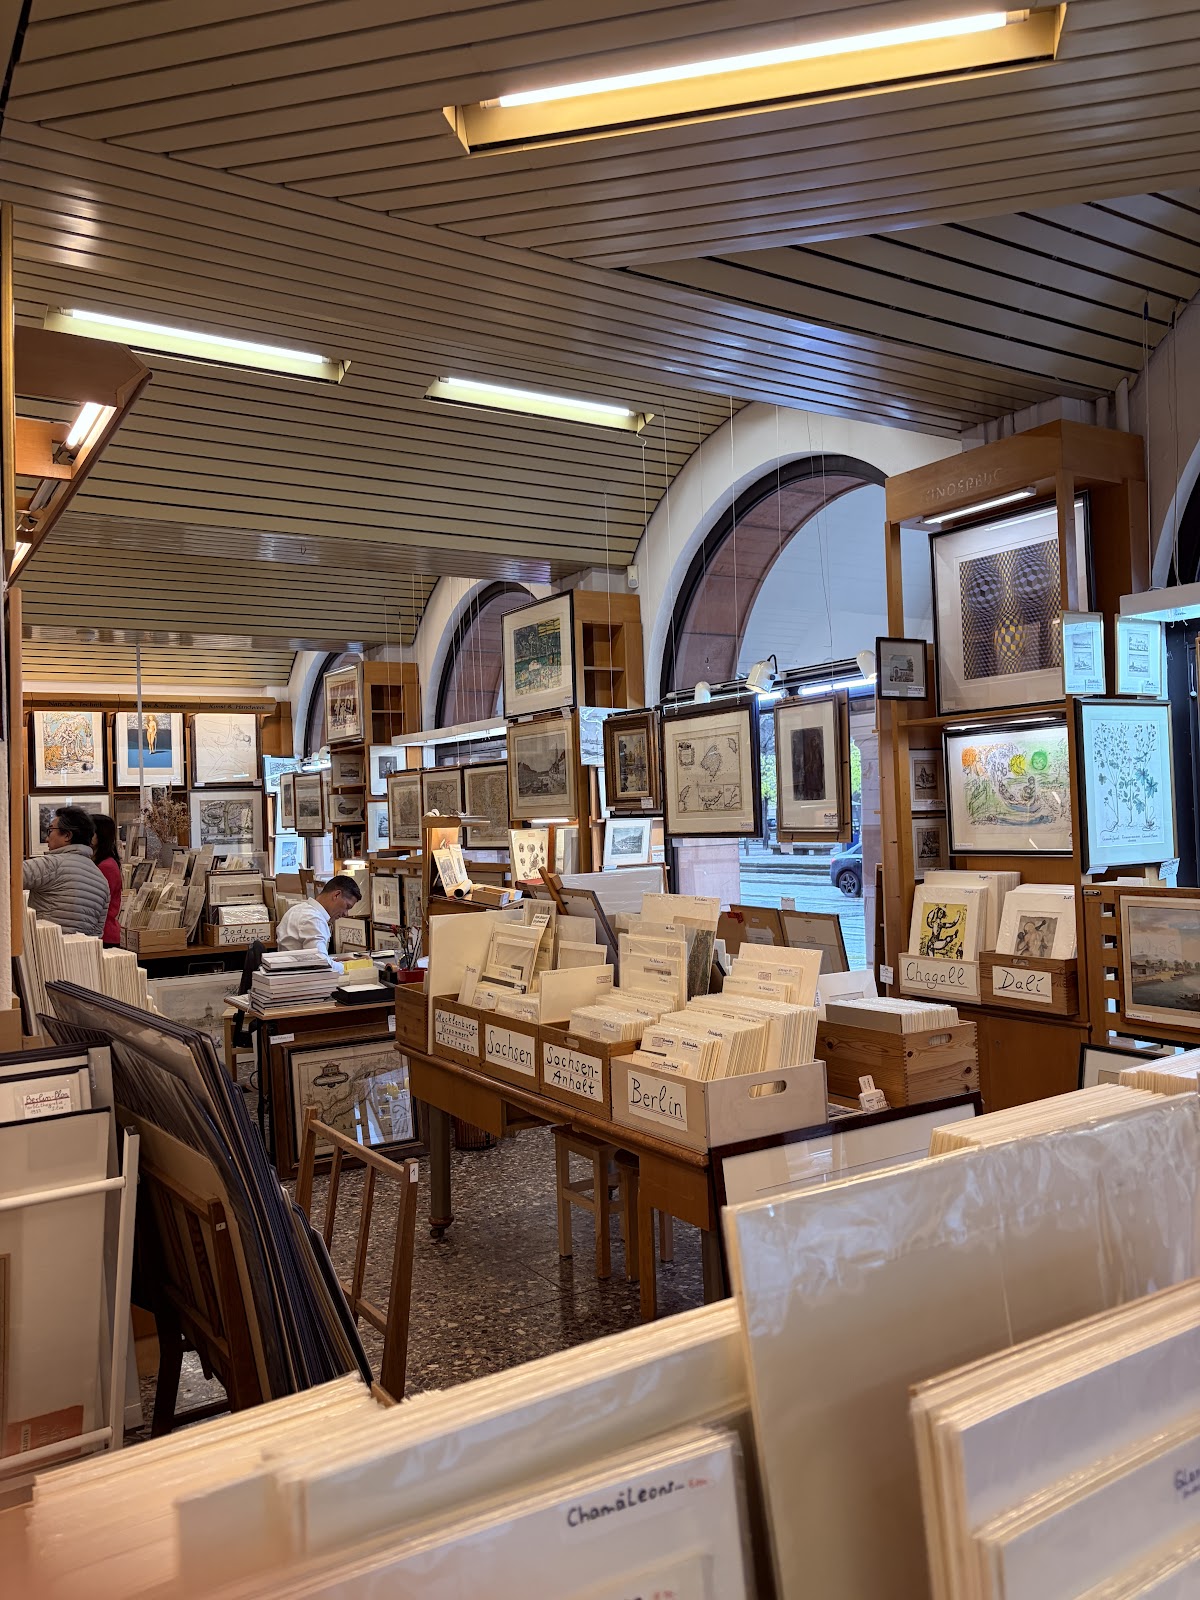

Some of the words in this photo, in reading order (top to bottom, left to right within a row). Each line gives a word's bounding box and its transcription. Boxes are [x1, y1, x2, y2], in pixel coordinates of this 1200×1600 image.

[222, 926, 264, 935] Baden-
[224, 933, 271, 943] Württemberg
[906, 962, 965, 989] Chagall
[998, 968, 1044, 993] Dalí
[436, 1011, 477, 1037] Mecklenburg-
[437, 1031, 475, 1052] Thüringen
[487, 1030, 532, 1065] Sachsen
[546, 1046, 599, 1078] Sachsen-
[552, 1070, 595, 1095] Anhalt
[631, 1077, 683, 1118] Berlin
